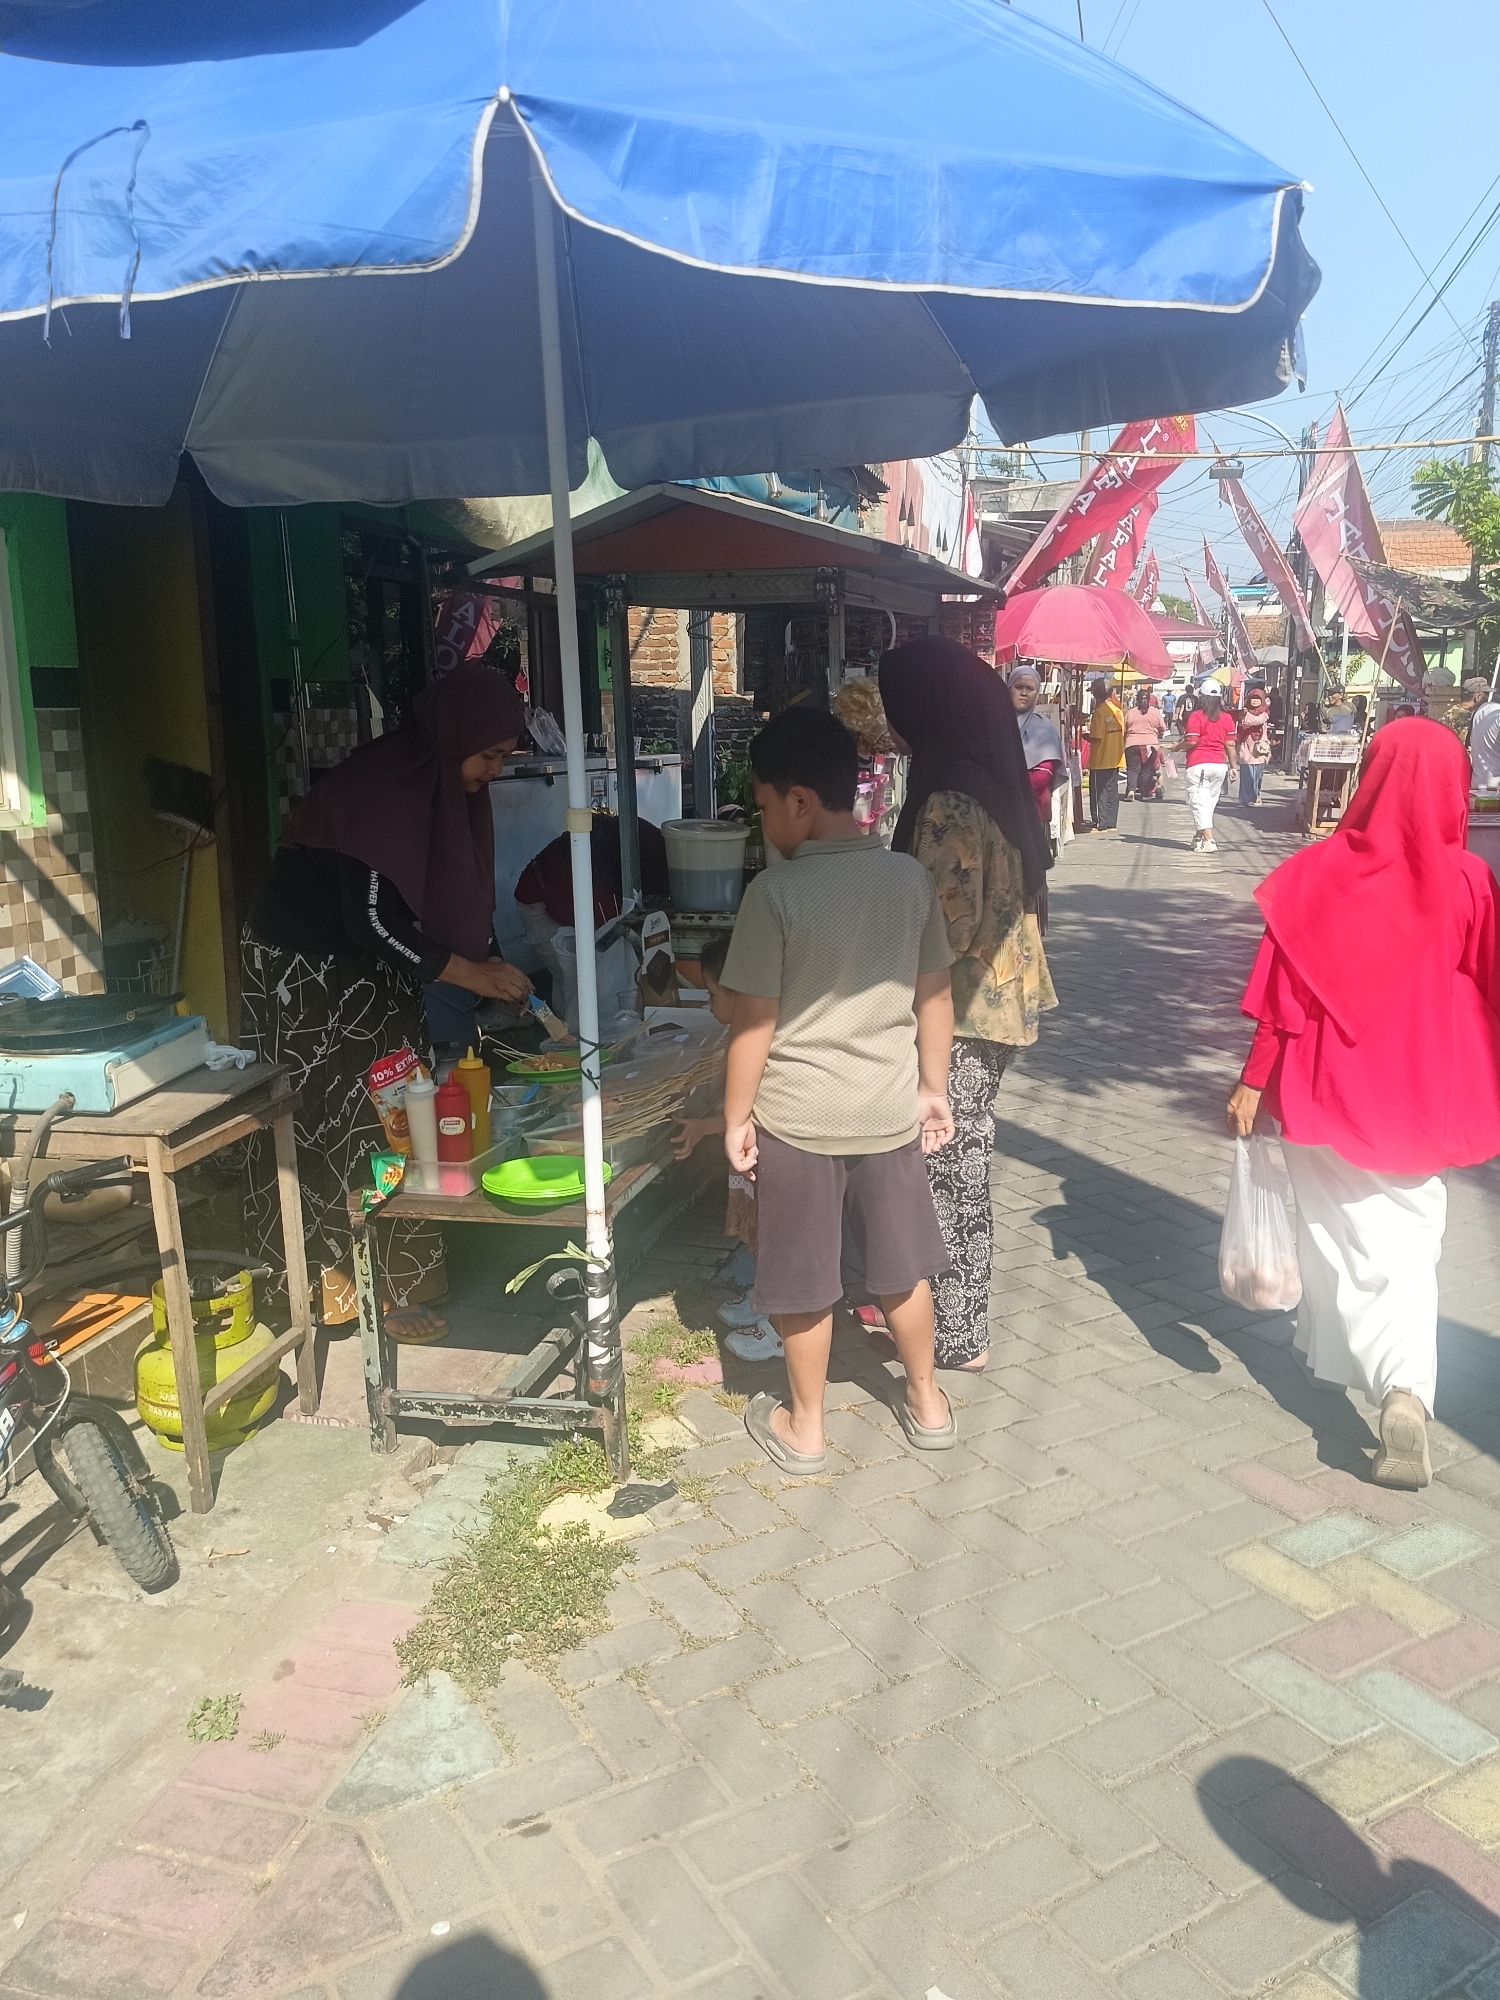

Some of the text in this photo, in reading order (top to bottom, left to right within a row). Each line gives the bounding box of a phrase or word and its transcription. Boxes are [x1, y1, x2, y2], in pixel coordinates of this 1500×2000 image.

[368, 869, 379, 906] HATEVER
[371, 1067, 394, 1083] 10%
[395, 1053, 419, 1072] EXTRA
